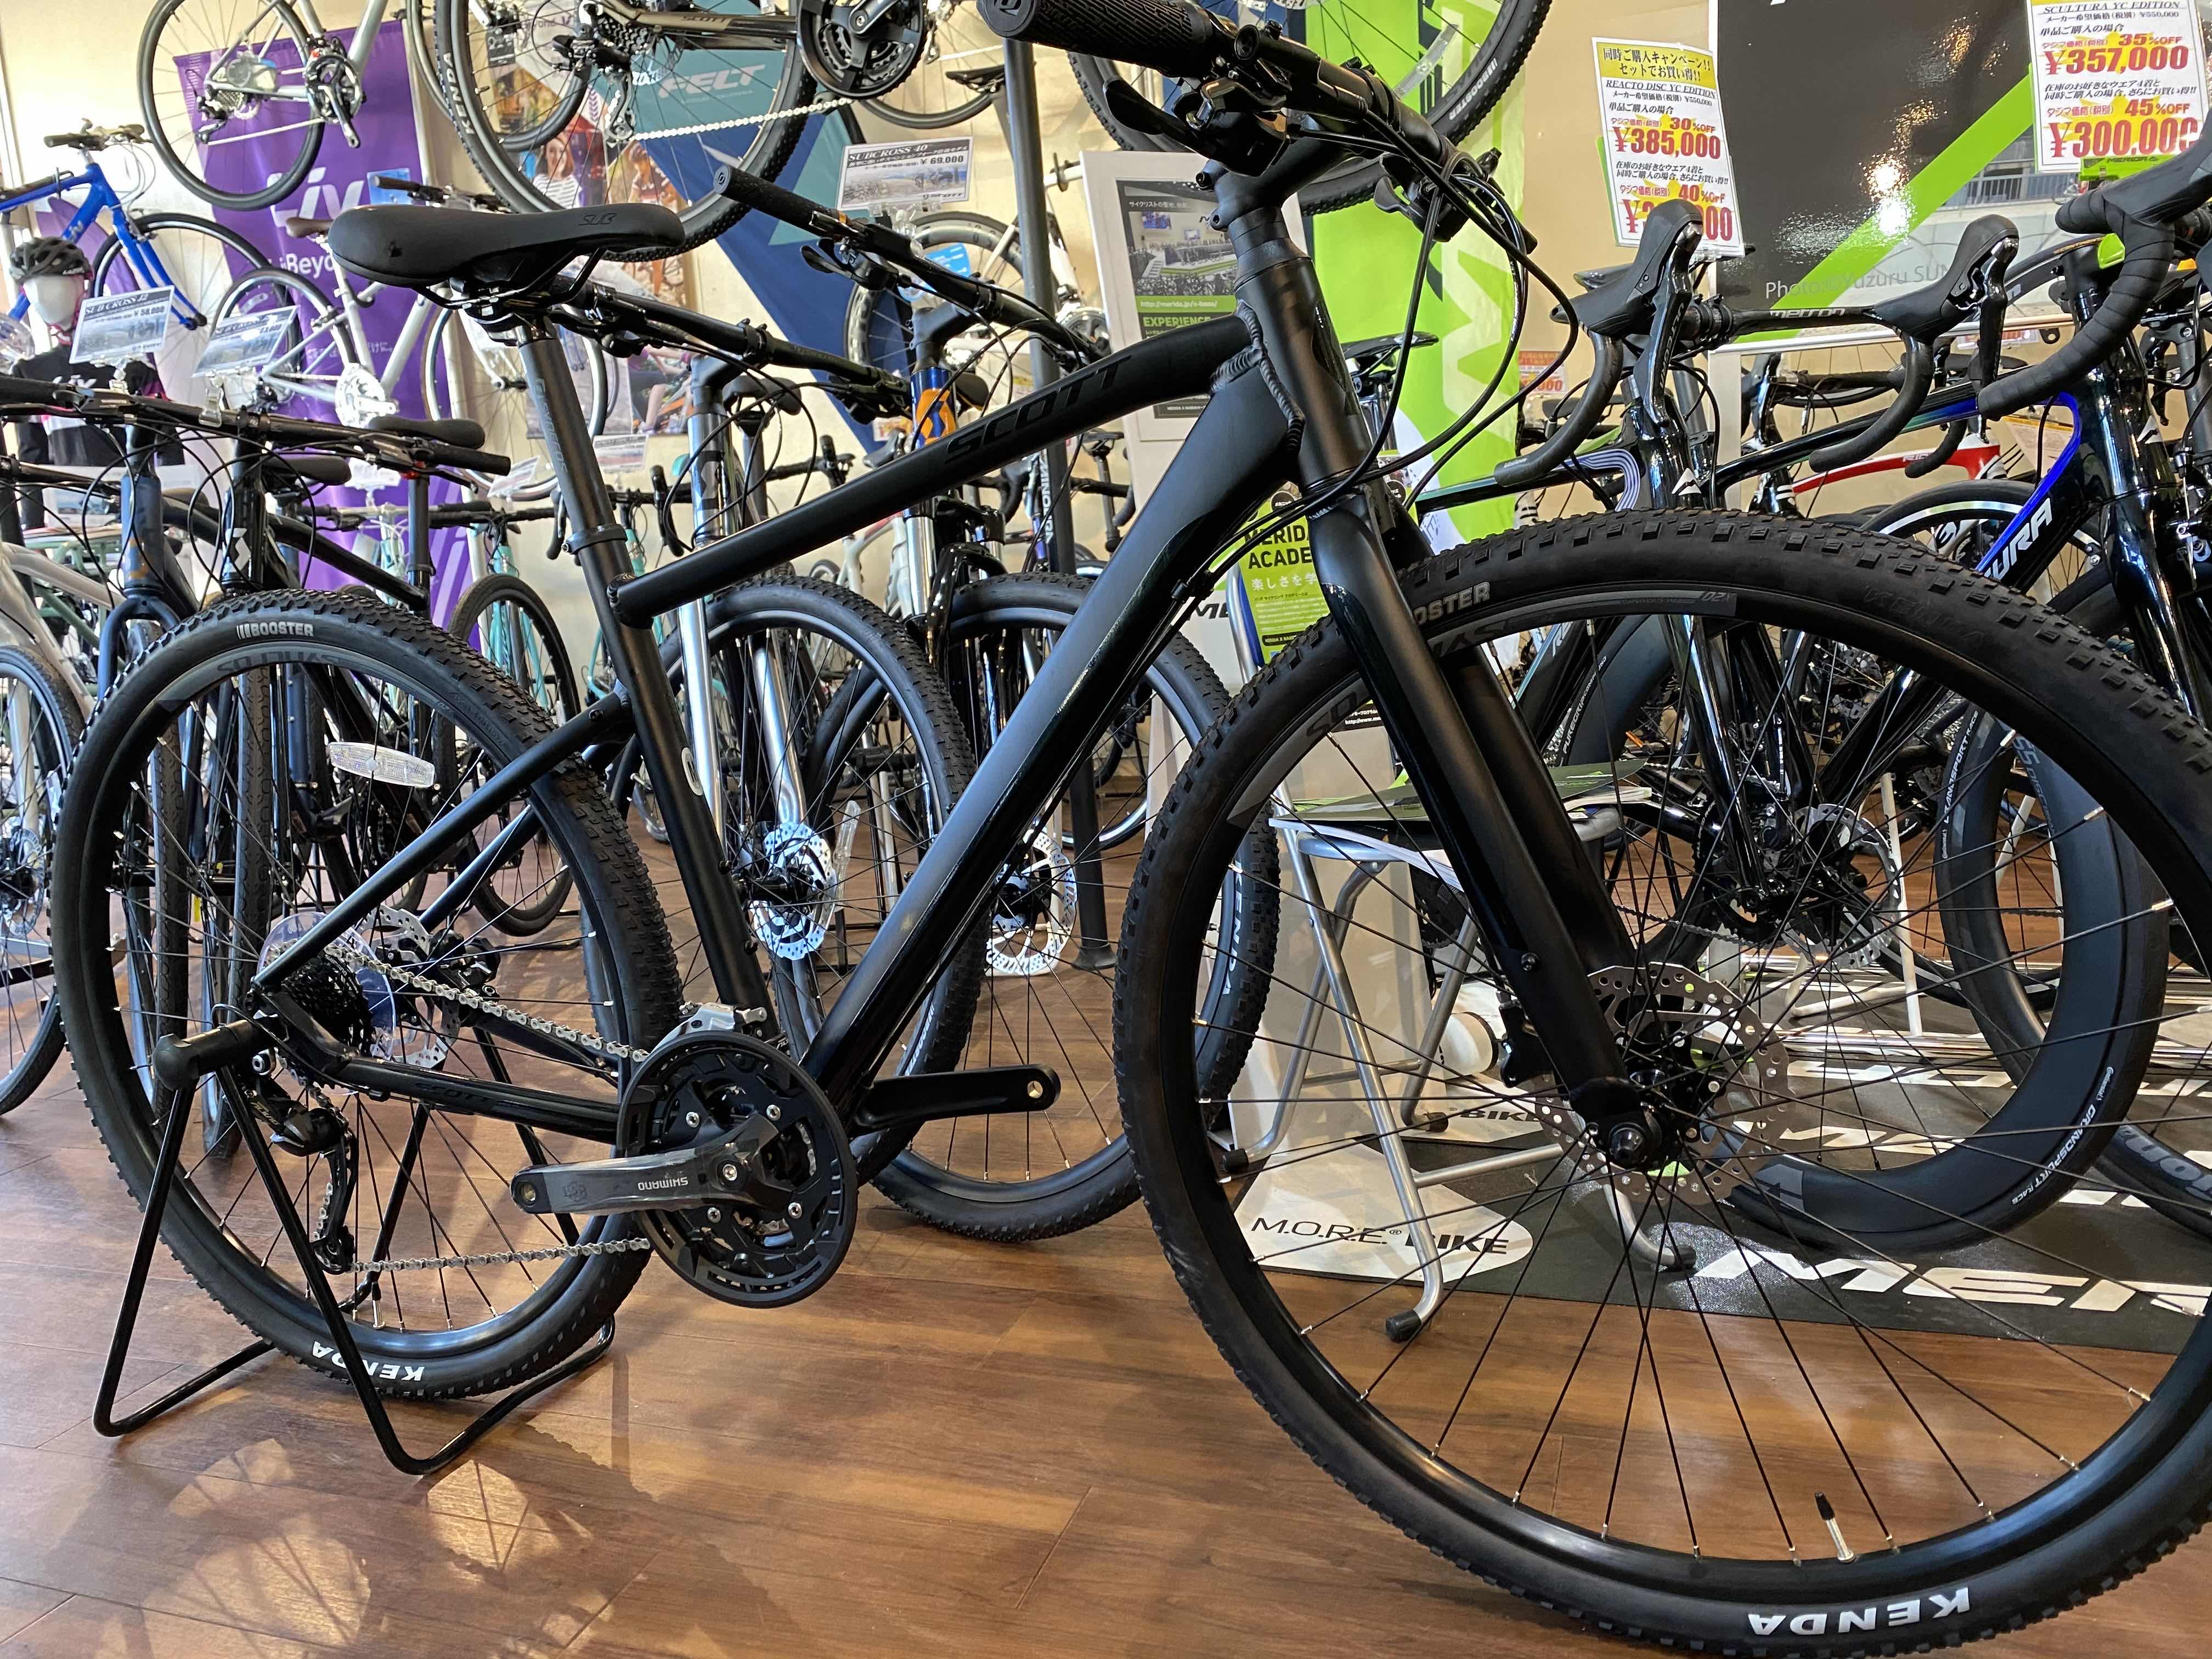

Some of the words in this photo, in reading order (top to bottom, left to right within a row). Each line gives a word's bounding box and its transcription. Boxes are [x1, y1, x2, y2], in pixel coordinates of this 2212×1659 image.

[2043, 3, 2108, 14] SCULTURA
[2132, 1, 2180, 9] EDITION
[2044, 46, 2189, 75] ¥357,000
[442, 52, 475, 136] KENDA
[659, 64, 766, 99] FELT
[1606, 80, 1644, 90] REACTO
[1646, 82, 1667, 91] DISC
[1669, 84, 1681, 92] YC
[1684, 86, 1716, 99] EDITION
[848, 147, 911, 161] SUBCROSS
[1612, 126, 1721, 160] ¥385,000
[578, 212, 618, 227] SUB
[1769, 307, 1846, 319] metron
[1660, 302, 1684, 388] ULTEGRA
[946, 355, 1131, 459] SCOTT
[1244, 524, 1310, 545] MERID
[1984, 497, 2053, 580] URA
[250, 622, 314, 637] BOOSTER
[1222, 860, 1242, 995] KENDA
[637, 1176, 689, 1190] SHIMANO
[1748, 1586, 1972, 1637] KENDA
